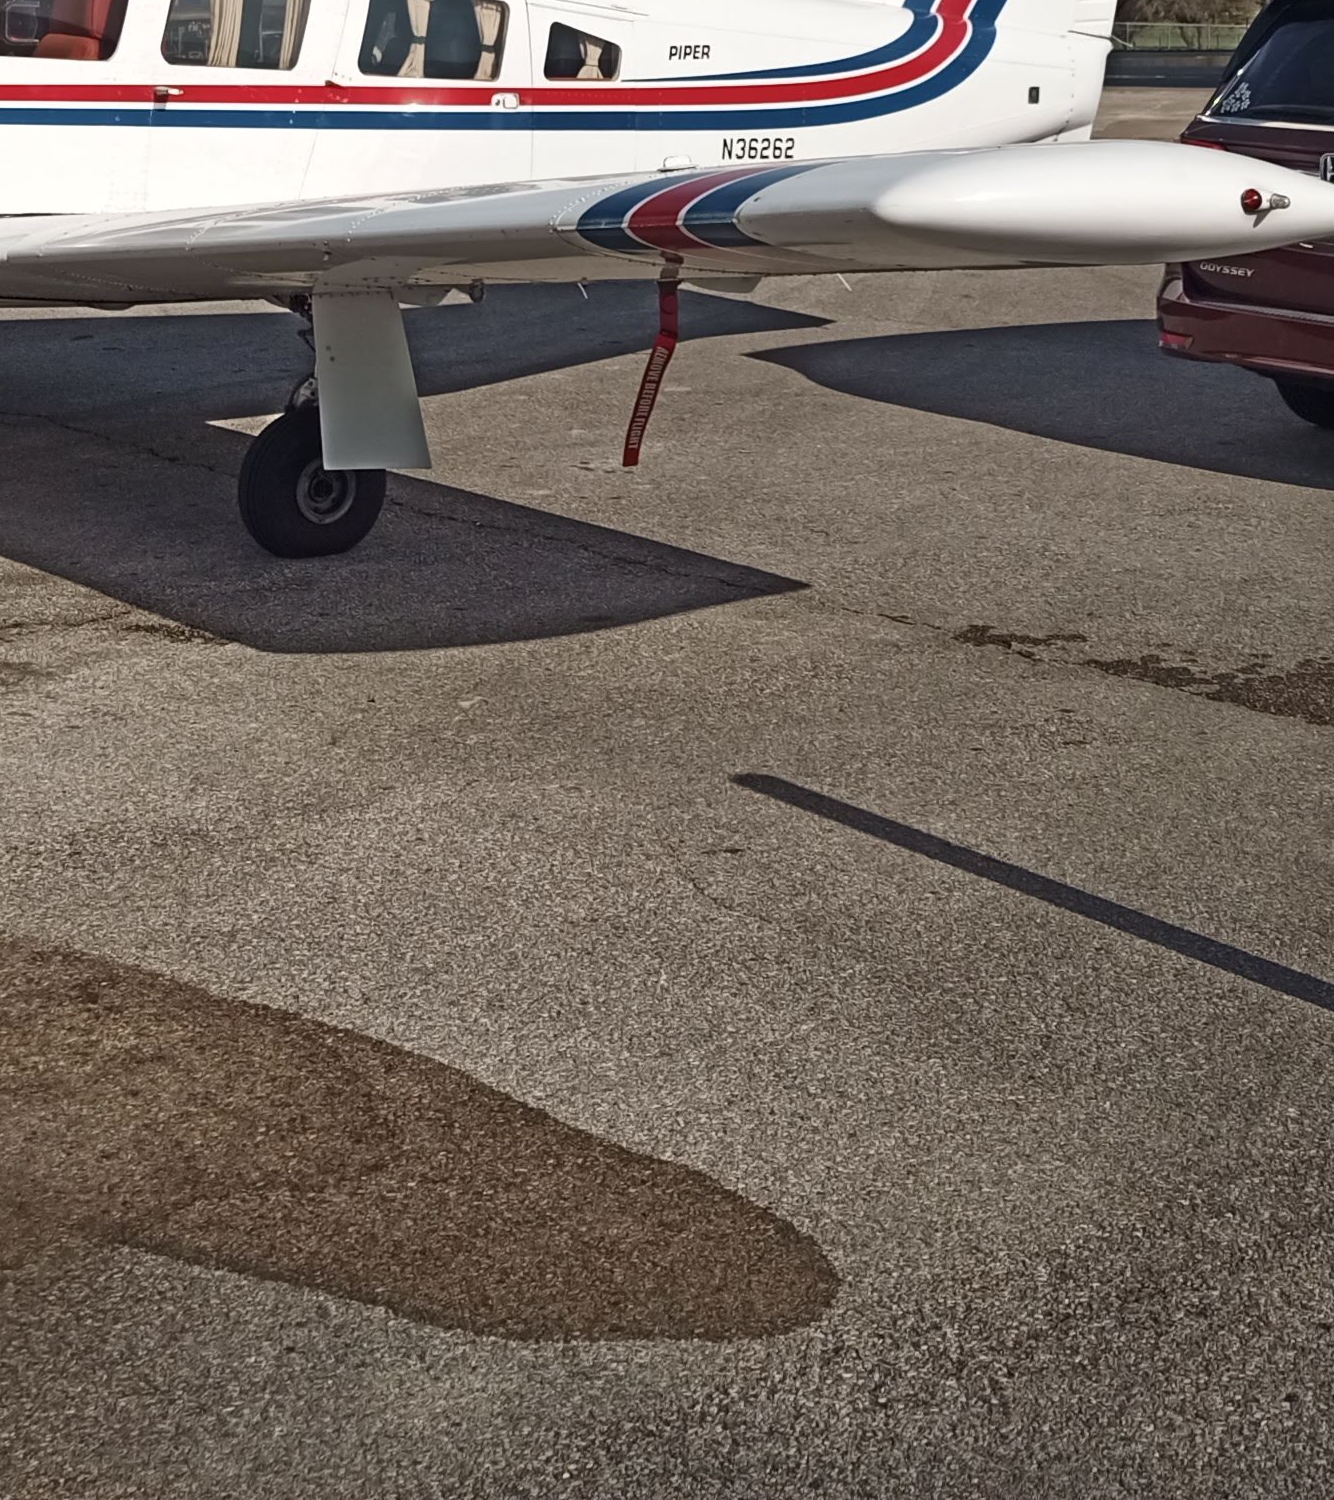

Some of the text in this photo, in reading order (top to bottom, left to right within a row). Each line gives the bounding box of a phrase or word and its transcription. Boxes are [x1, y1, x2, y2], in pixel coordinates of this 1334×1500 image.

[669, 45, 711, 60] PIPER
[722, 138, 795, 160] N36262
[1200, 261, 1255, 277] ODYSSEY
[628, 346, 669, 449] REMOVE BEFORE FLIGHT
